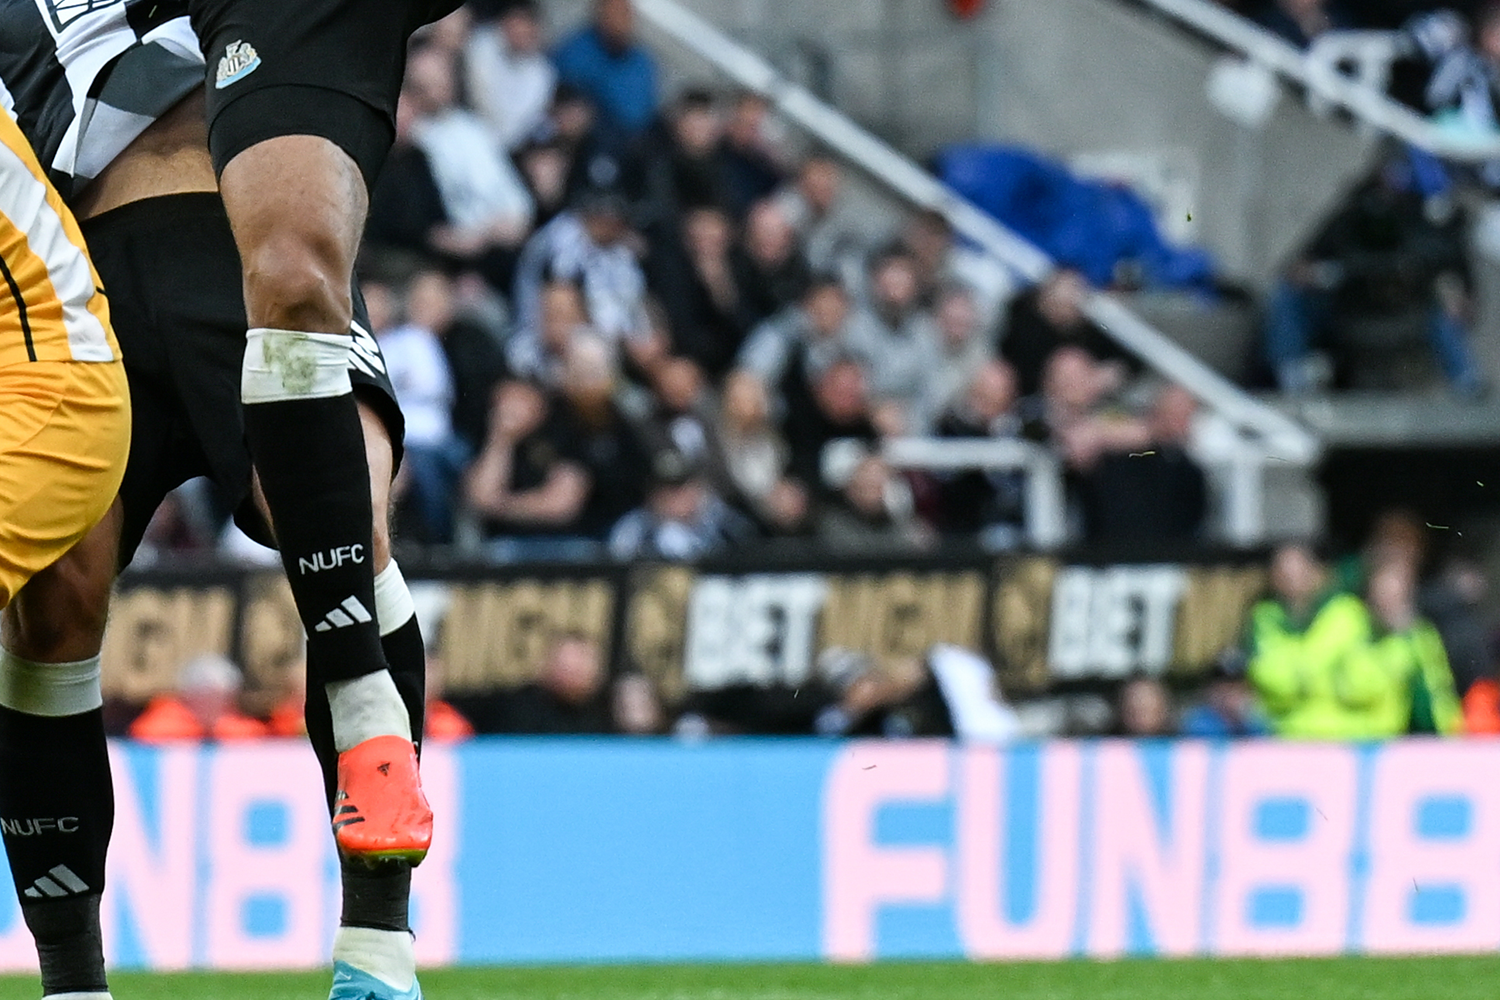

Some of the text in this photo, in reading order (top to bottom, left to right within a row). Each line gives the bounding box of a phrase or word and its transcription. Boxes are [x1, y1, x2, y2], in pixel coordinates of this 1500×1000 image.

[298, 543, 365, 575] NUFC
[0, 816, 79, 835] NUFC
[821, 736, 1500, 964] FUN88
